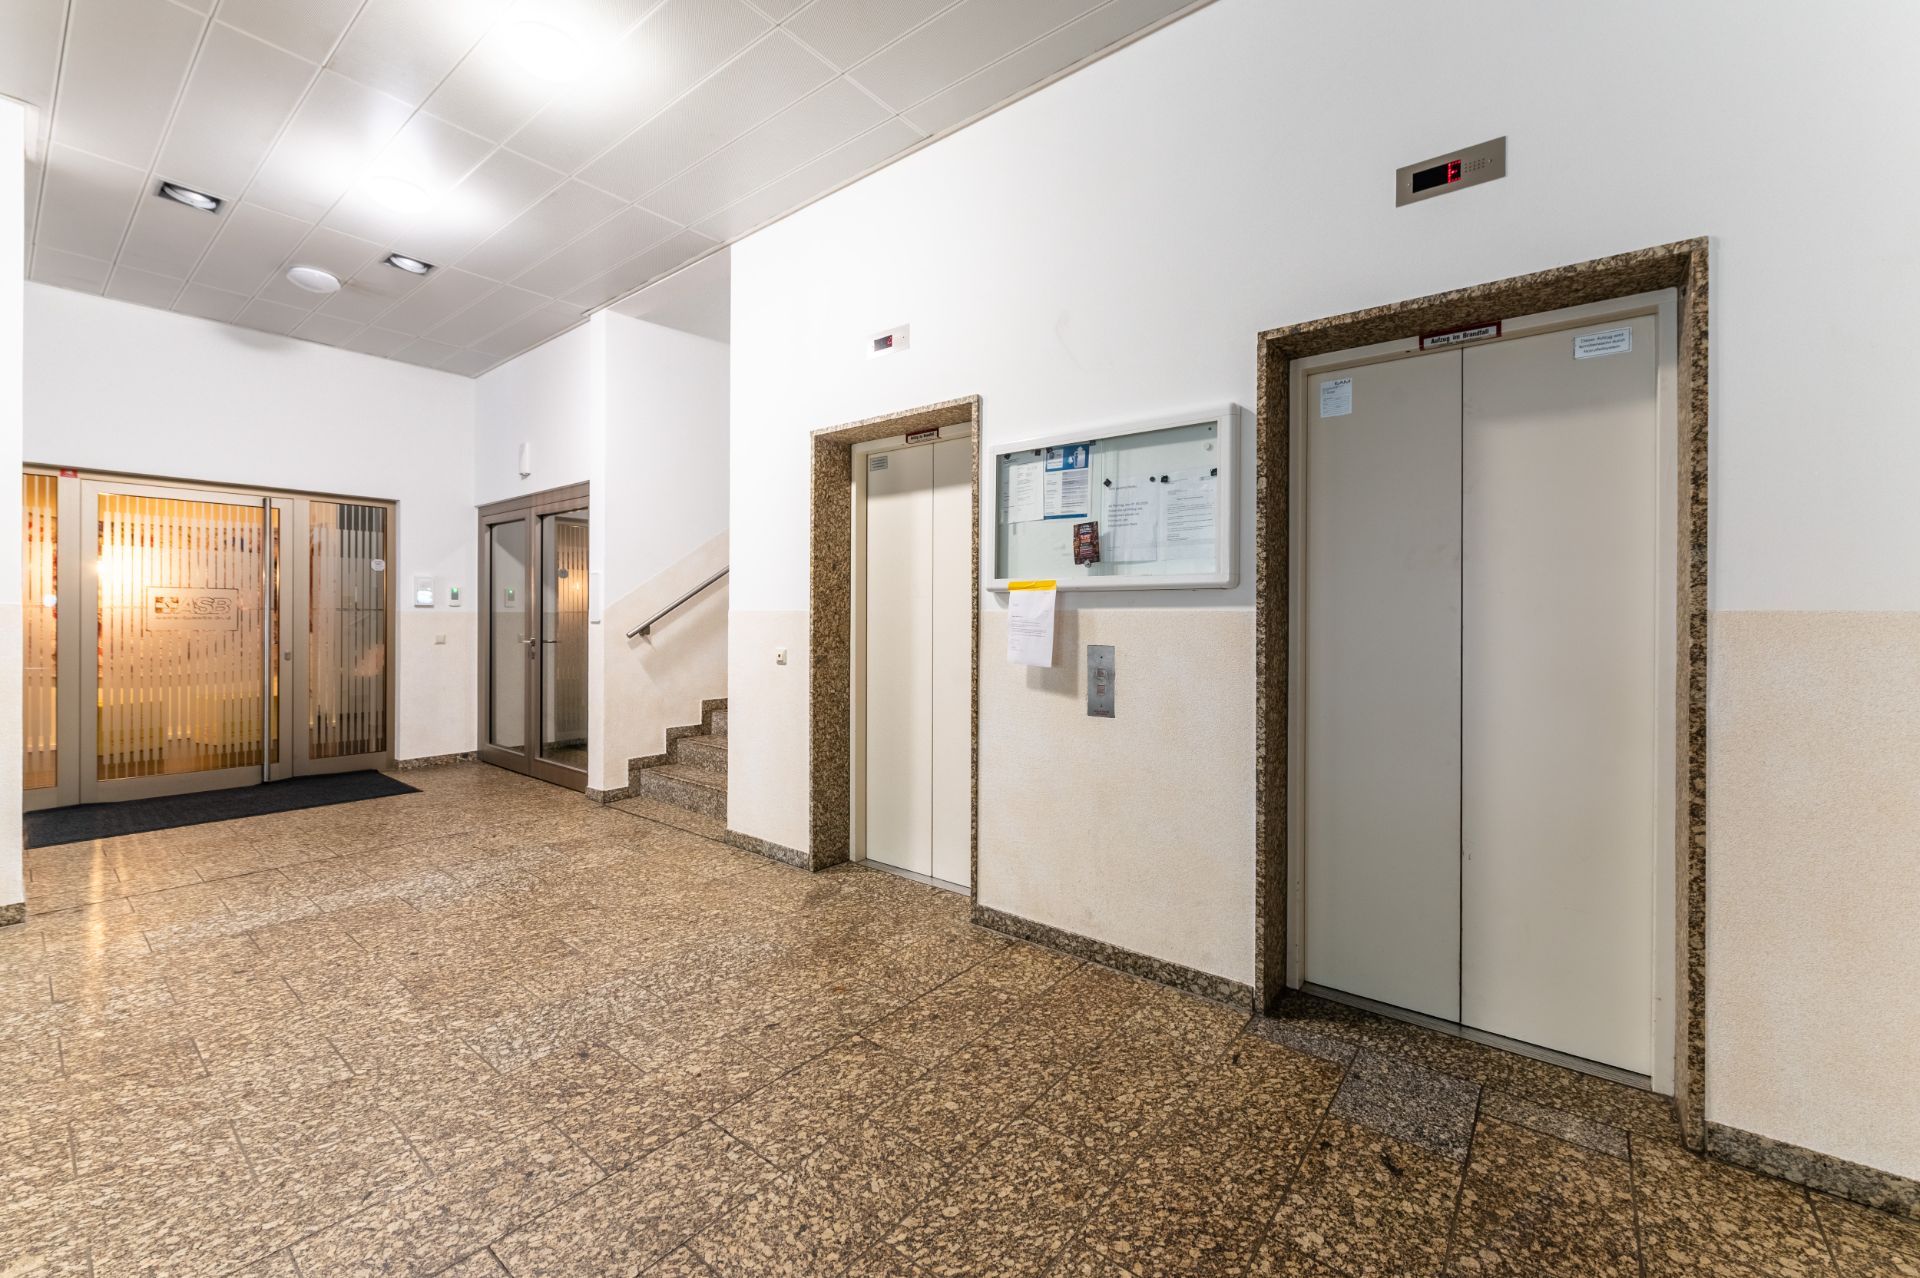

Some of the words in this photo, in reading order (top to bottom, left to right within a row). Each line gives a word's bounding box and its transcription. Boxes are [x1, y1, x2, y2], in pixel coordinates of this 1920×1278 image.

[1447, 160, 1461, 184] E
[1431, 336, 1450, 344] Aufzug
[1462, 328, 1489, 339] Brandfall
[179, 596, 232, 614] ASB
